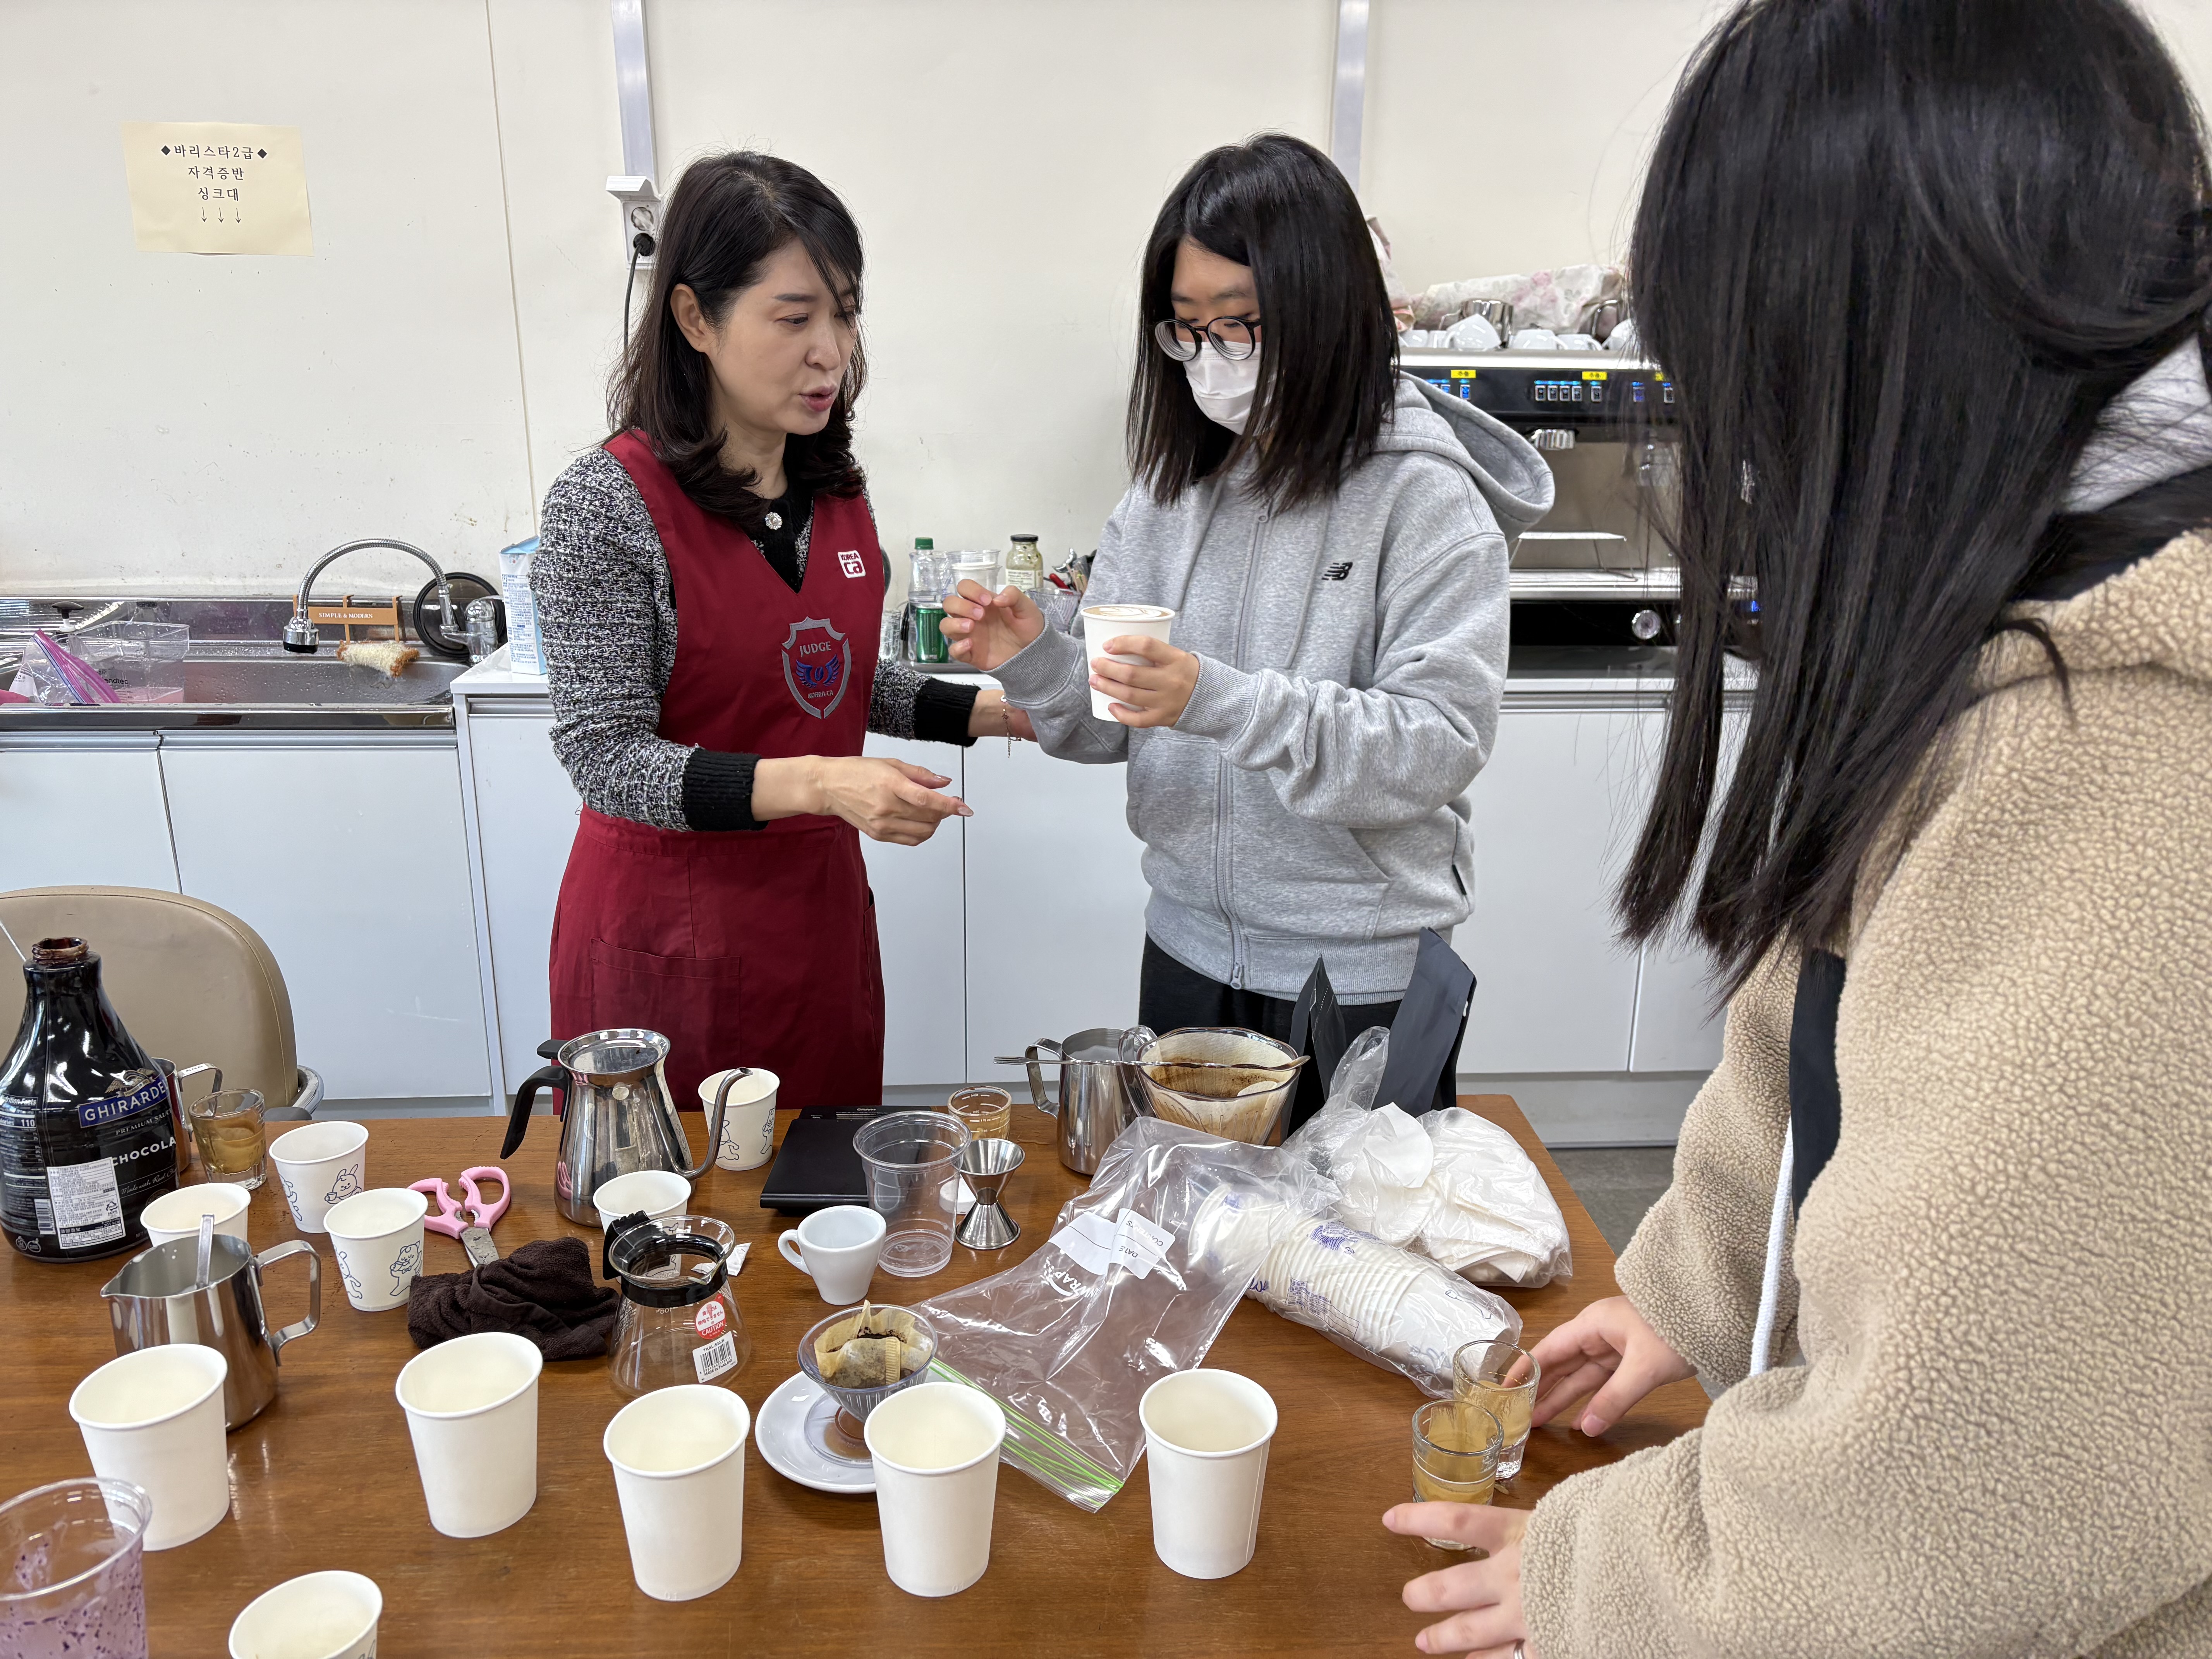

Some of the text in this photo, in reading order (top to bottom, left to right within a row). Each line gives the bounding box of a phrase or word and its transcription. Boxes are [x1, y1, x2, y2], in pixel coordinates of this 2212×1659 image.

[174, 144, 254, 159] 바리스타2급
[188, 166, 244, 180] 자격증반
[198, 187, 239, 201] 싱크대
[799, 641, 831, 657] JUDGE
[116, 1118, 153, 1135] PREMIUM
[139, 1179, 151, 1188] with
[1118, 1245, 1139, 1258] DATE
[702, 1321, 724, 1336] CAUTION
[719, 1359, 732, 1369] THAILAND
